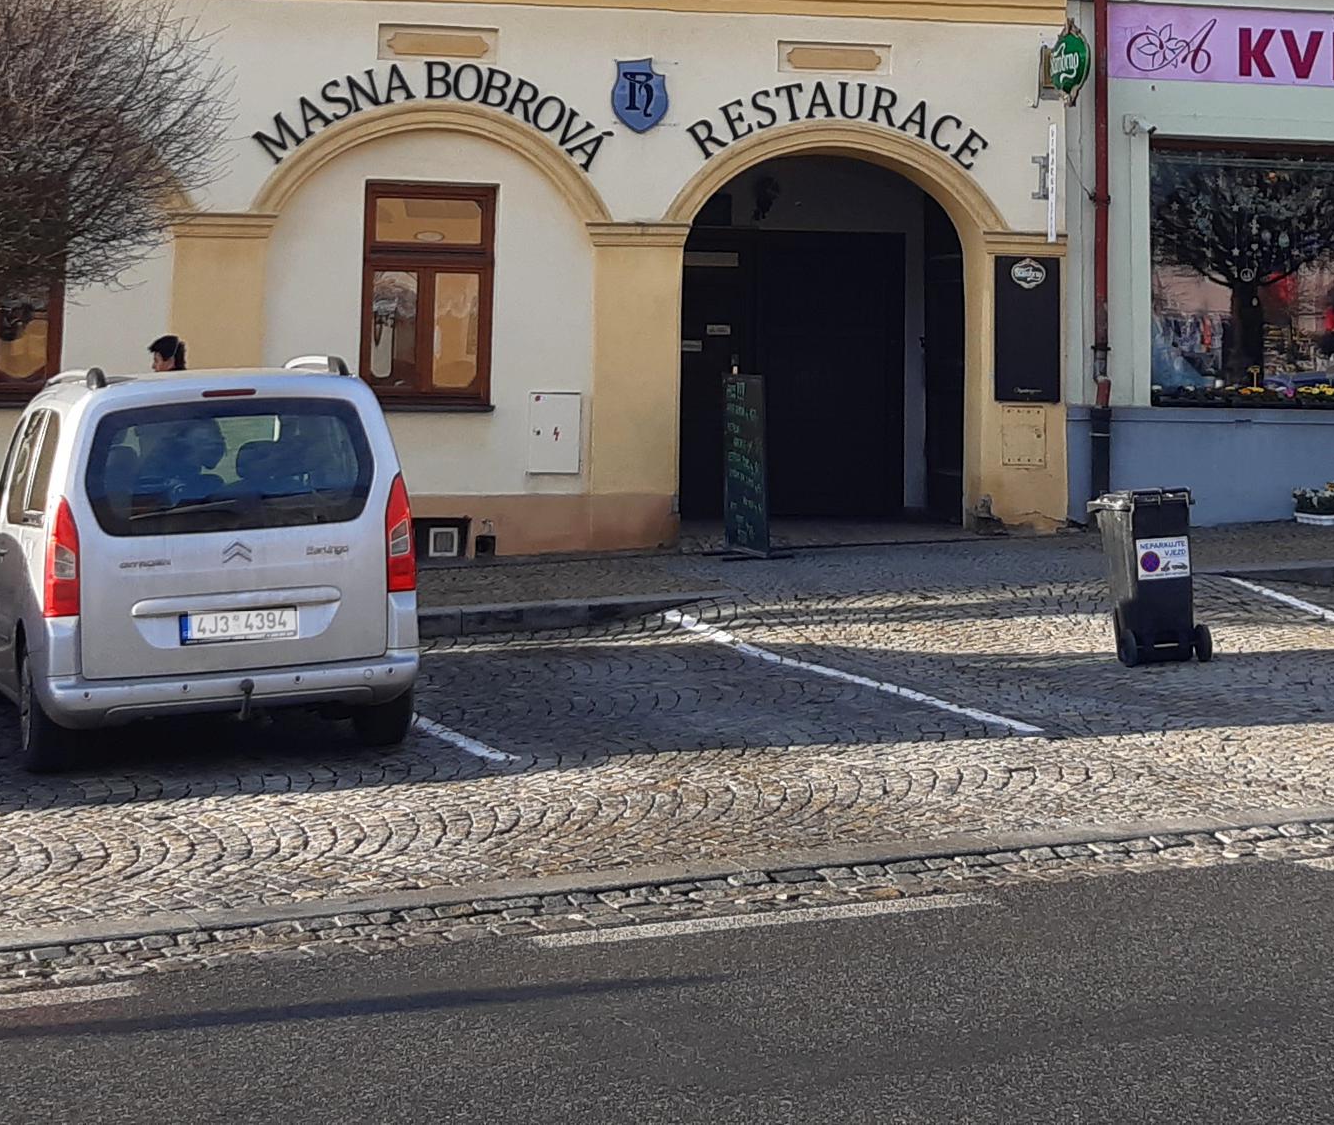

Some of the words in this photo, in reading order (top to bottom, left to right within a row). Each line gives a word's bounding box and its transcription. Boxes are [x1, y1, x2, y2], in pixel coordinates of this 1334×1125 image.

[252, 64, 416, 165] MASNA
[424, 60, 615, 172] BOBROVÁ
[686, 81, 990, 171] RESTAURACE
[305, 545, 350, 556] Berlingo
[196, 615, 231, 635] 4J3
[244, 610, 288, 630] 4394
